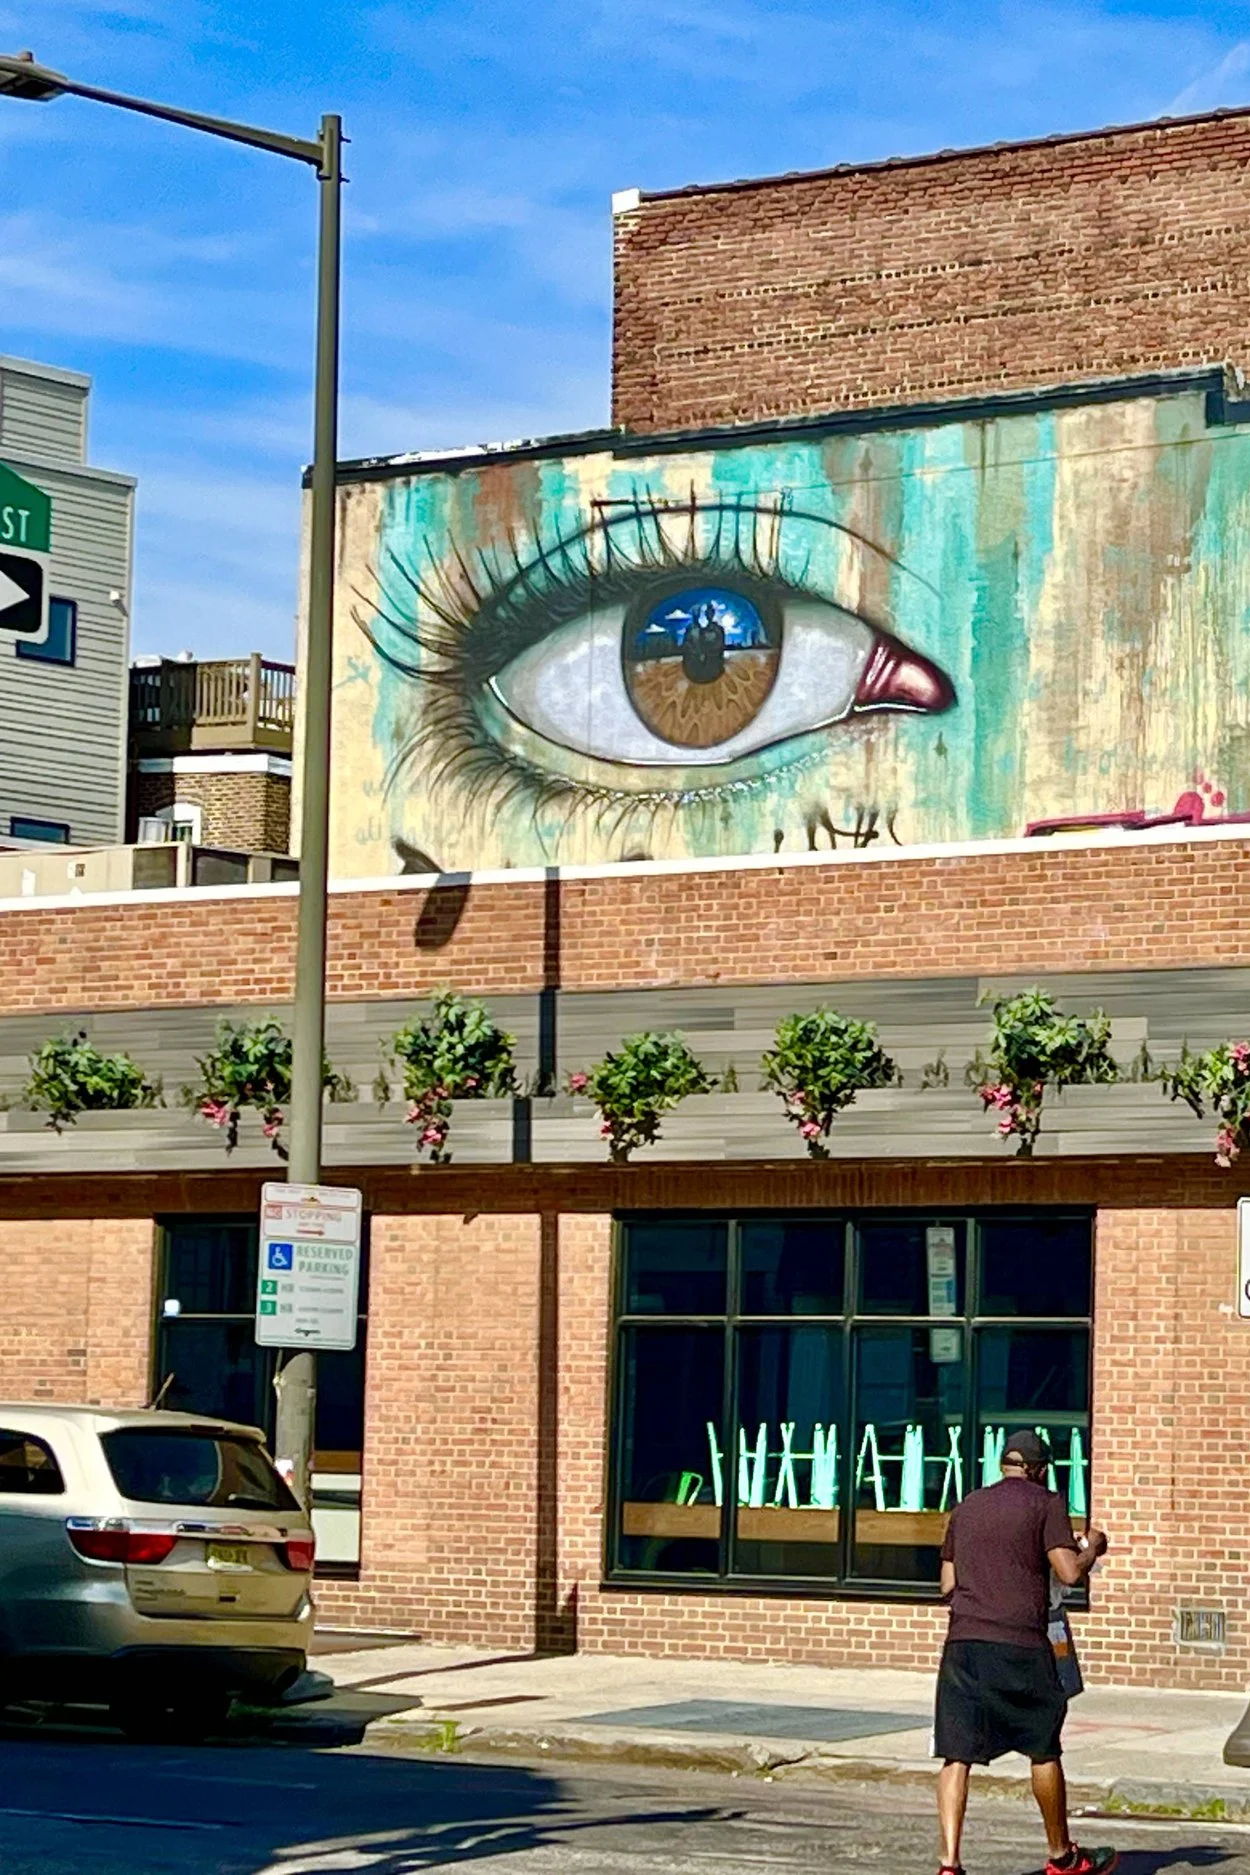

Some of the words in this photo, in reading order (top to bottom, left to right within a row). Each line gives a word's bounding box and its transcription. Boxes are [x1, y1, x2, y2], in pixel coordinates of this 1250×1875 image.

[1, 506, 30, 542] ST
[297, 1246, 353, 1260] RESERVED
[299, 1260, 349, 1276] PARKING
